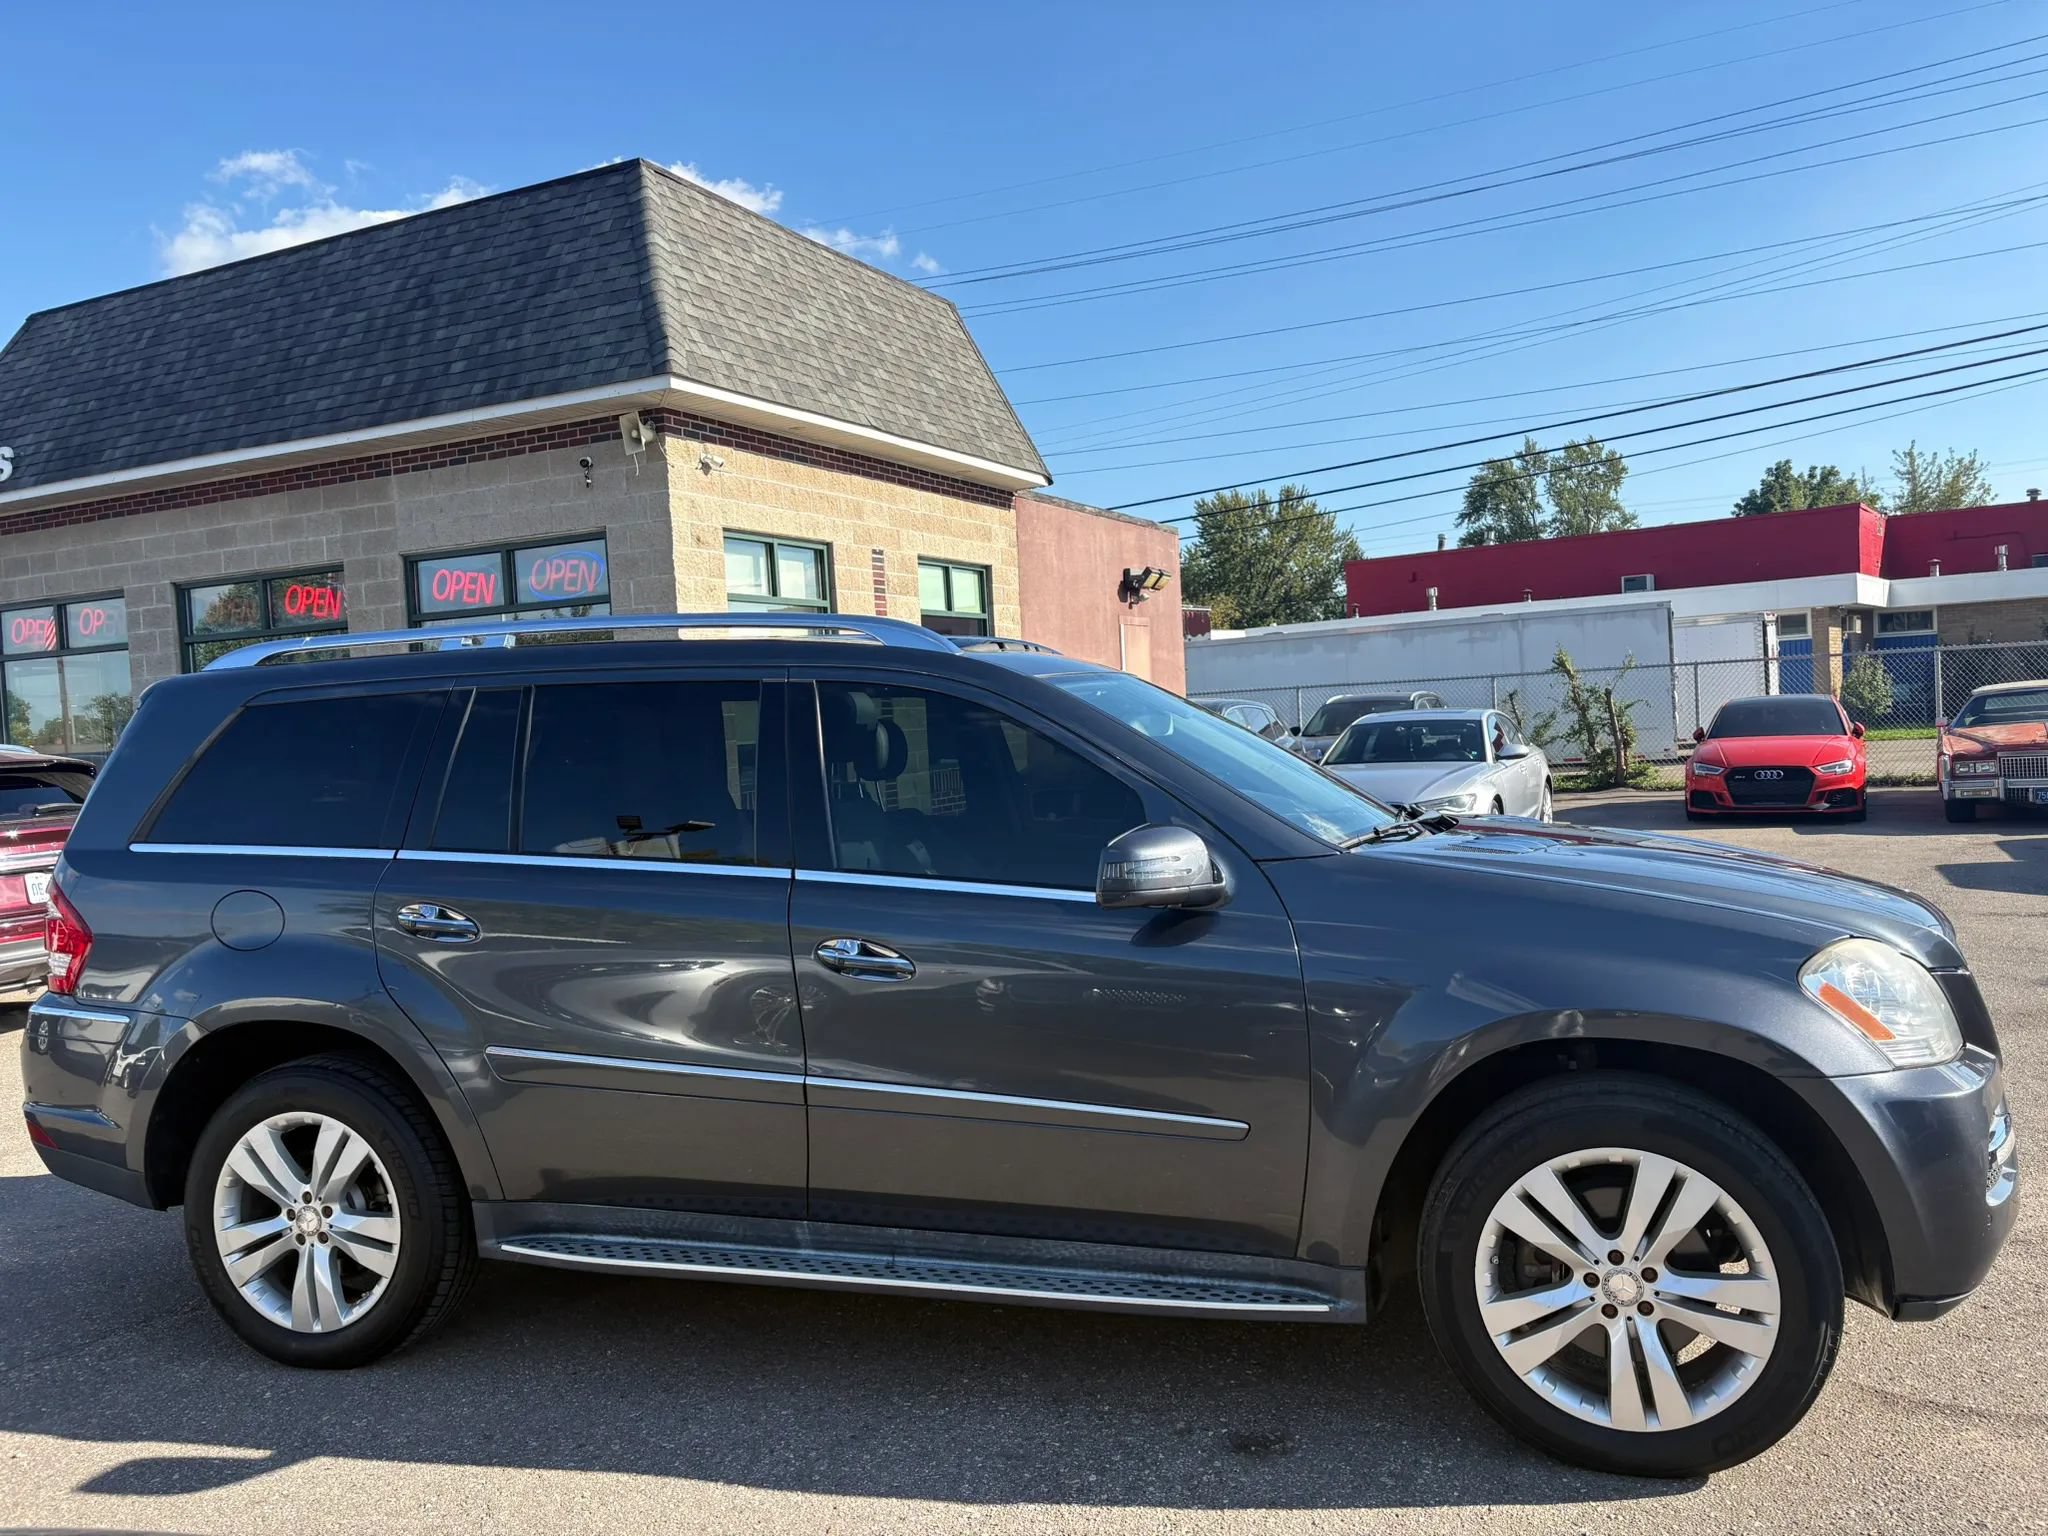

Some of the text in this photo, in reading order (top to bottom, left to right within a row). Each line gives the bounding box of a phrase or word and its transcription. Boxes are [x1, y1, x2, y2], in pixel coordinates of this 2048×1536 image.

[432, 569, 496, 606] OPEN
[531, 558, 598, 593] OPEN
[285, 584, 342, 620] OPEN
